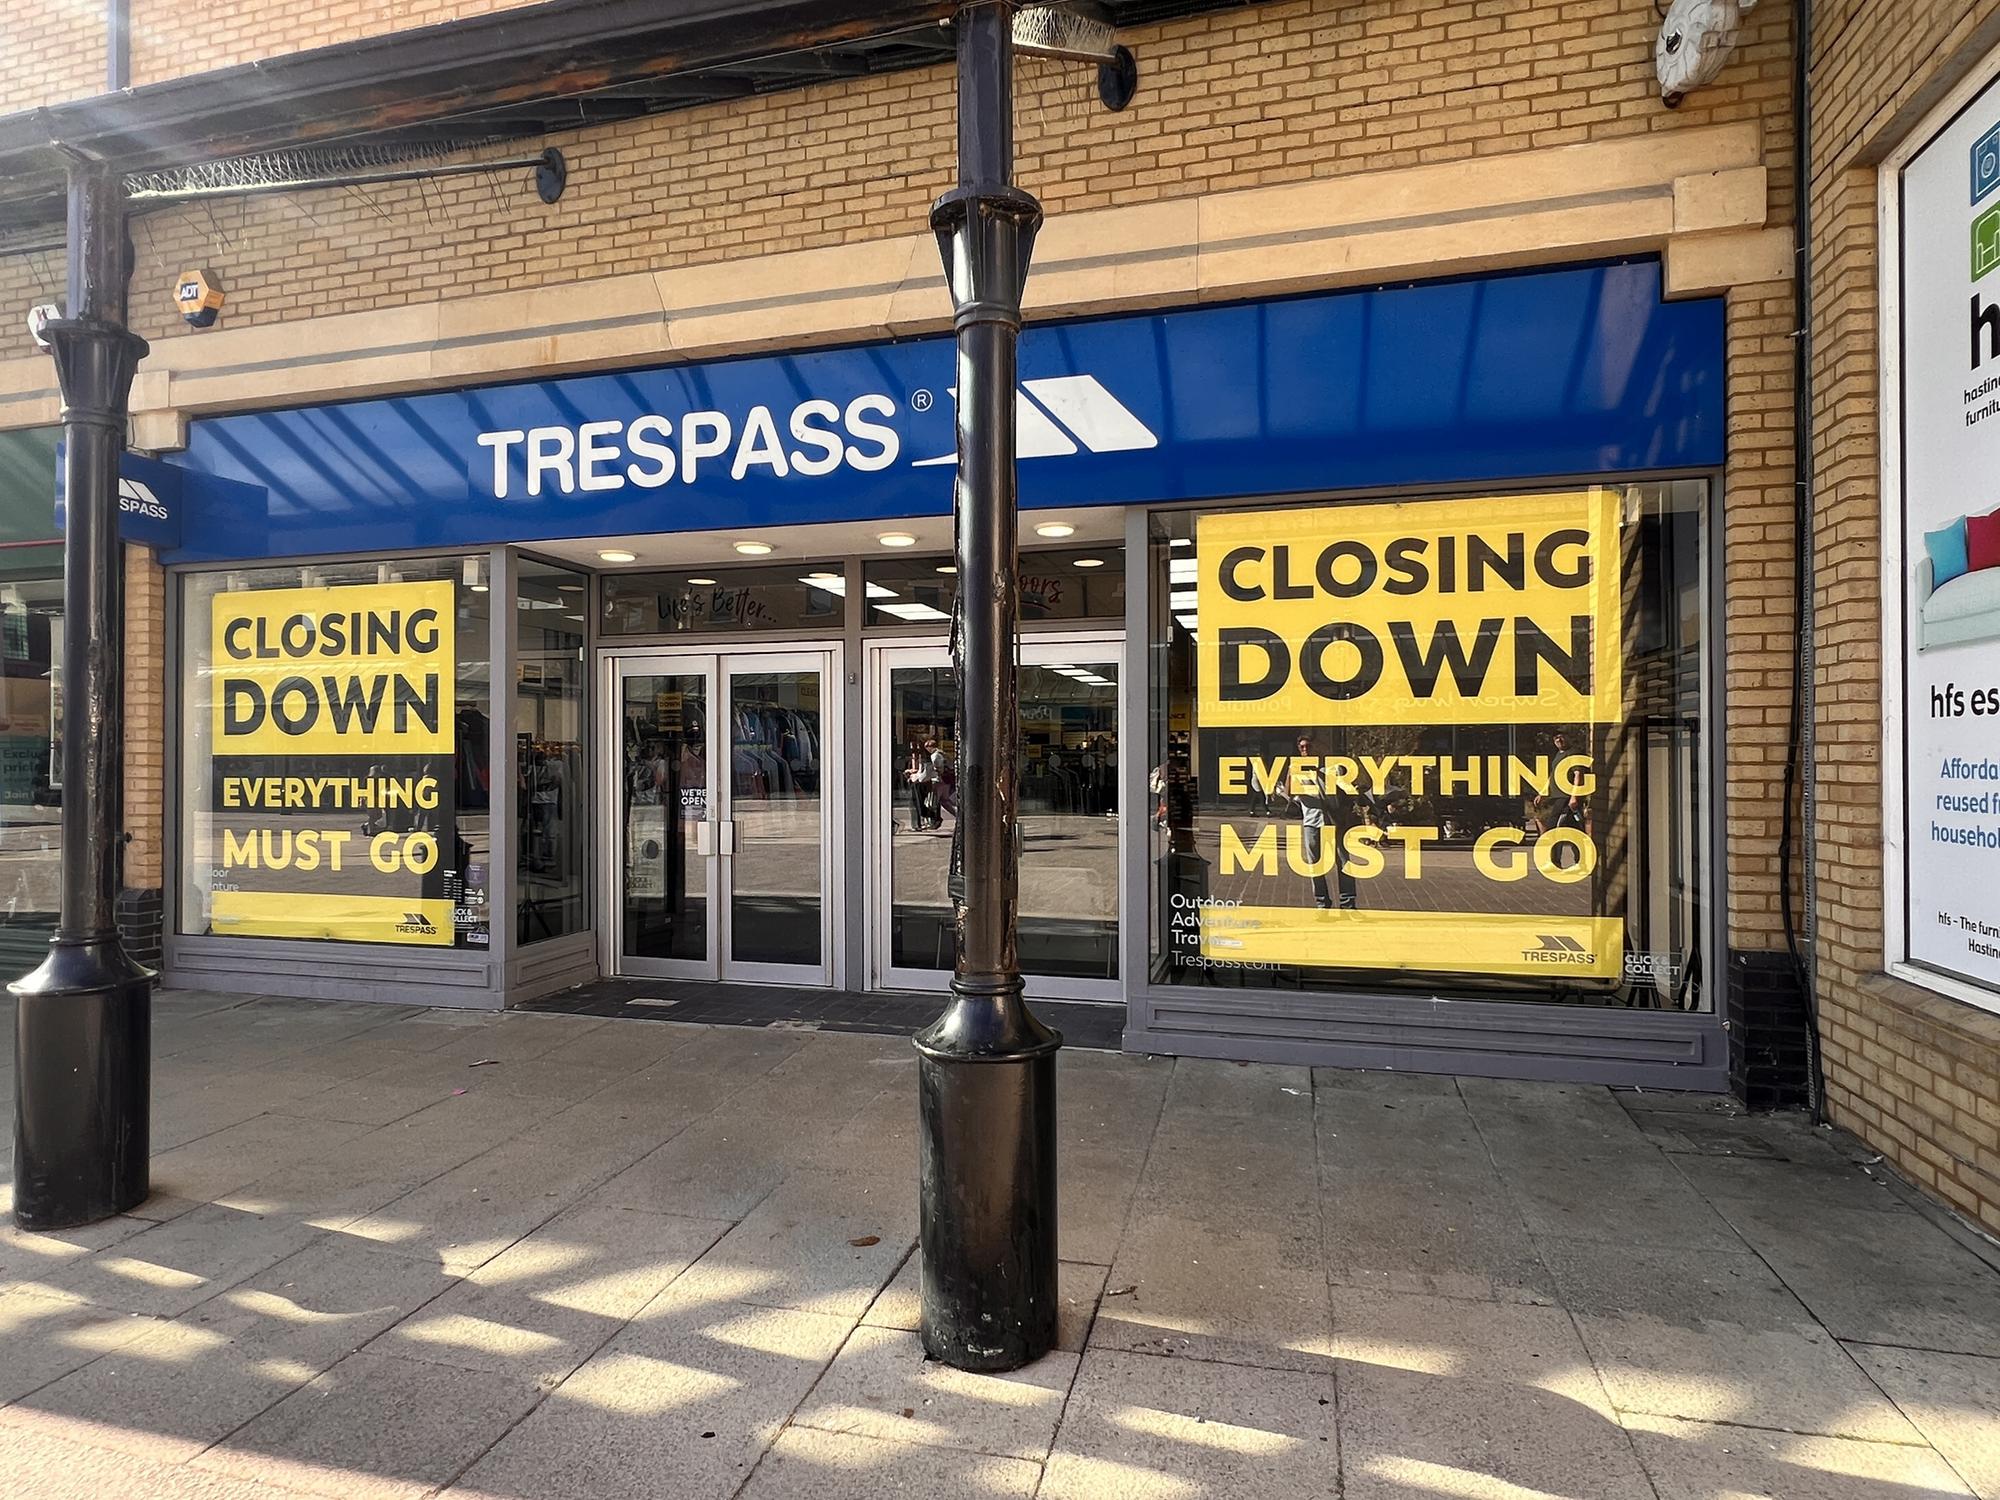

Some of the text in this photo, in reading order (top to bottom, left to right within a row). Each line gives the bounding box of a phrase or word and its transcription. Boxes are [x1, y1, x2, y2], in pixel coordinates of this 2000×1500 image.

[181, 284, 198, 299] ADT
[1964, 376, 2000, 405] hastin
[477, 394, 899, 498] TRESPASS
[119, 498, 168, 520] SPASS
[1218, 528, 1592, 602] CLOSING
[224, 608, 439, 661] CLOSING
[1218, 614, 1594, 702] DOWN
[224, 673, 439, 736] DOWN
[1931, 683, 1965, 718] hfs
[1218, 754, 1597, 797] EVERYTHING
[1941, 757, 2000, 780] Afforda
[223, 777, 438, 810] EVERYTHING
[680, 788, 707, 797] WE'RE
[680, 796, 707, 806] OPEN
[1936, 792, 1989, 814] reused
[223, 828, 439, 875] MUST GO
[1219, 823, 1598, 884] MUST GO
[395, 925, 438, 935] TRESPASS
[1938, 911, 1951, 926] hfs
[1960, 916, 1977, 932] The
[1171, 950, 1281, 971] Trespass.com
[1521, 951, 1595, 964] TRESPASS
[1625, 964, 1680, 976] COLLECT
